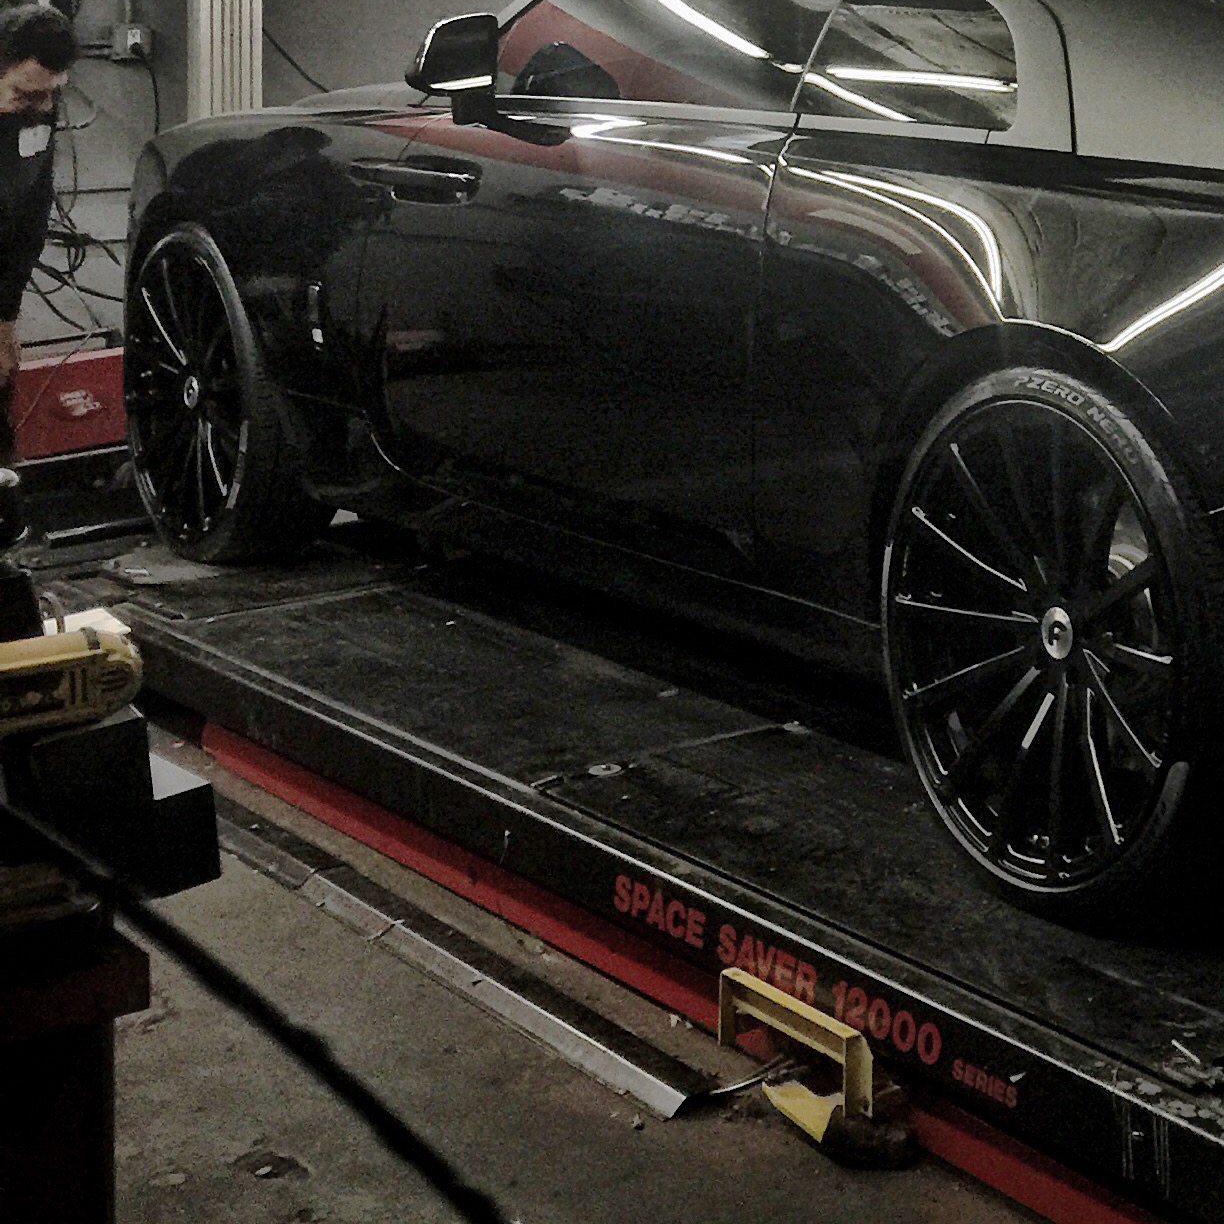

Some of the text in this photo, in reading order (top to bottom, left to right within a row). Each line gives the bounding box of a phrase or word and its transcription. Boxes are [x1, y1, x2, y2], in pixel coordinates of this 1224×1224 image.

[613, 874, 1018, 1109] SPACE SAVER 12000 SERIES
